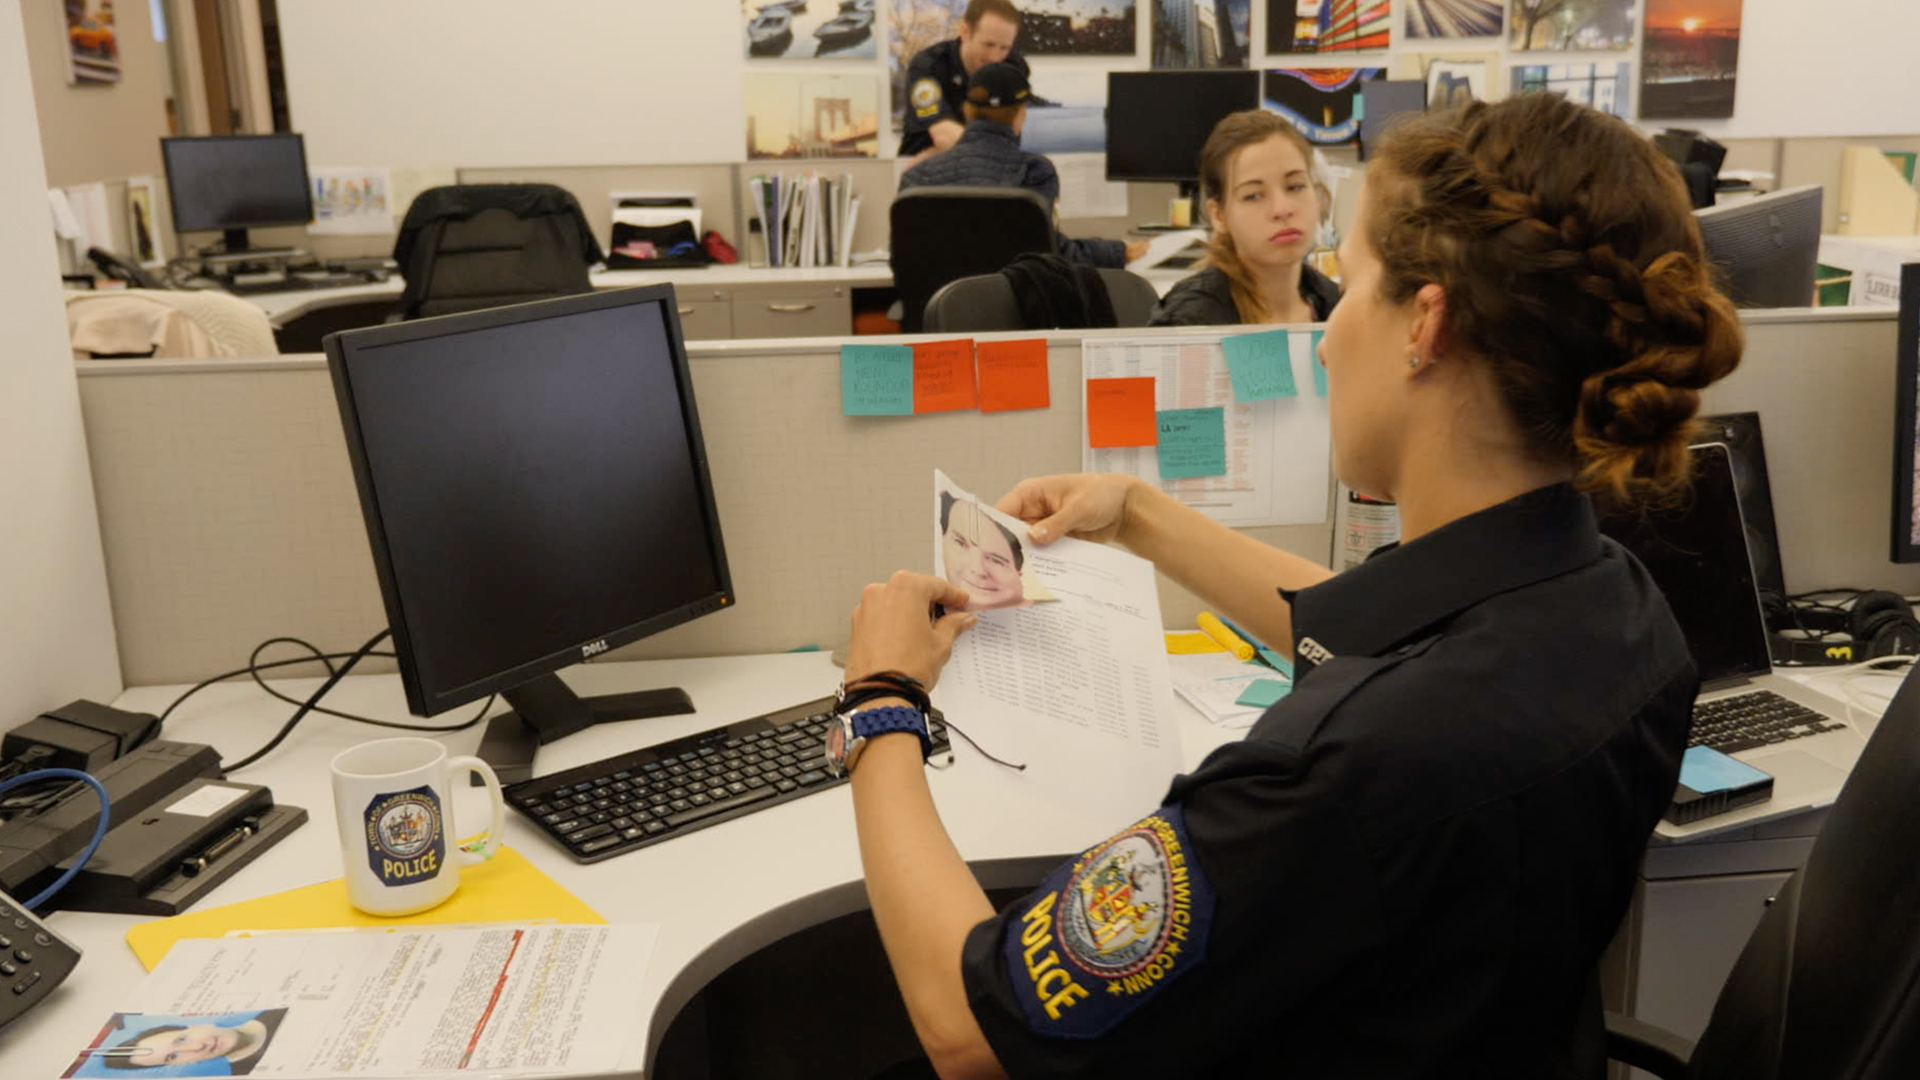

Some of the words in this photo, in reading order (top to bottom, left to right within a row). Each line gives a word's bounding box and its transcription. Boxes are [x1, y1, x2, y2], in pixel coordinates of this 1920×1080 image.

[582, 640, 608, 658] DELL
[382, 849, 437, 879] POLICE
[1020, 891, 1090, 1020] POLICE
[1123, 955, 1175, 995] CONN
